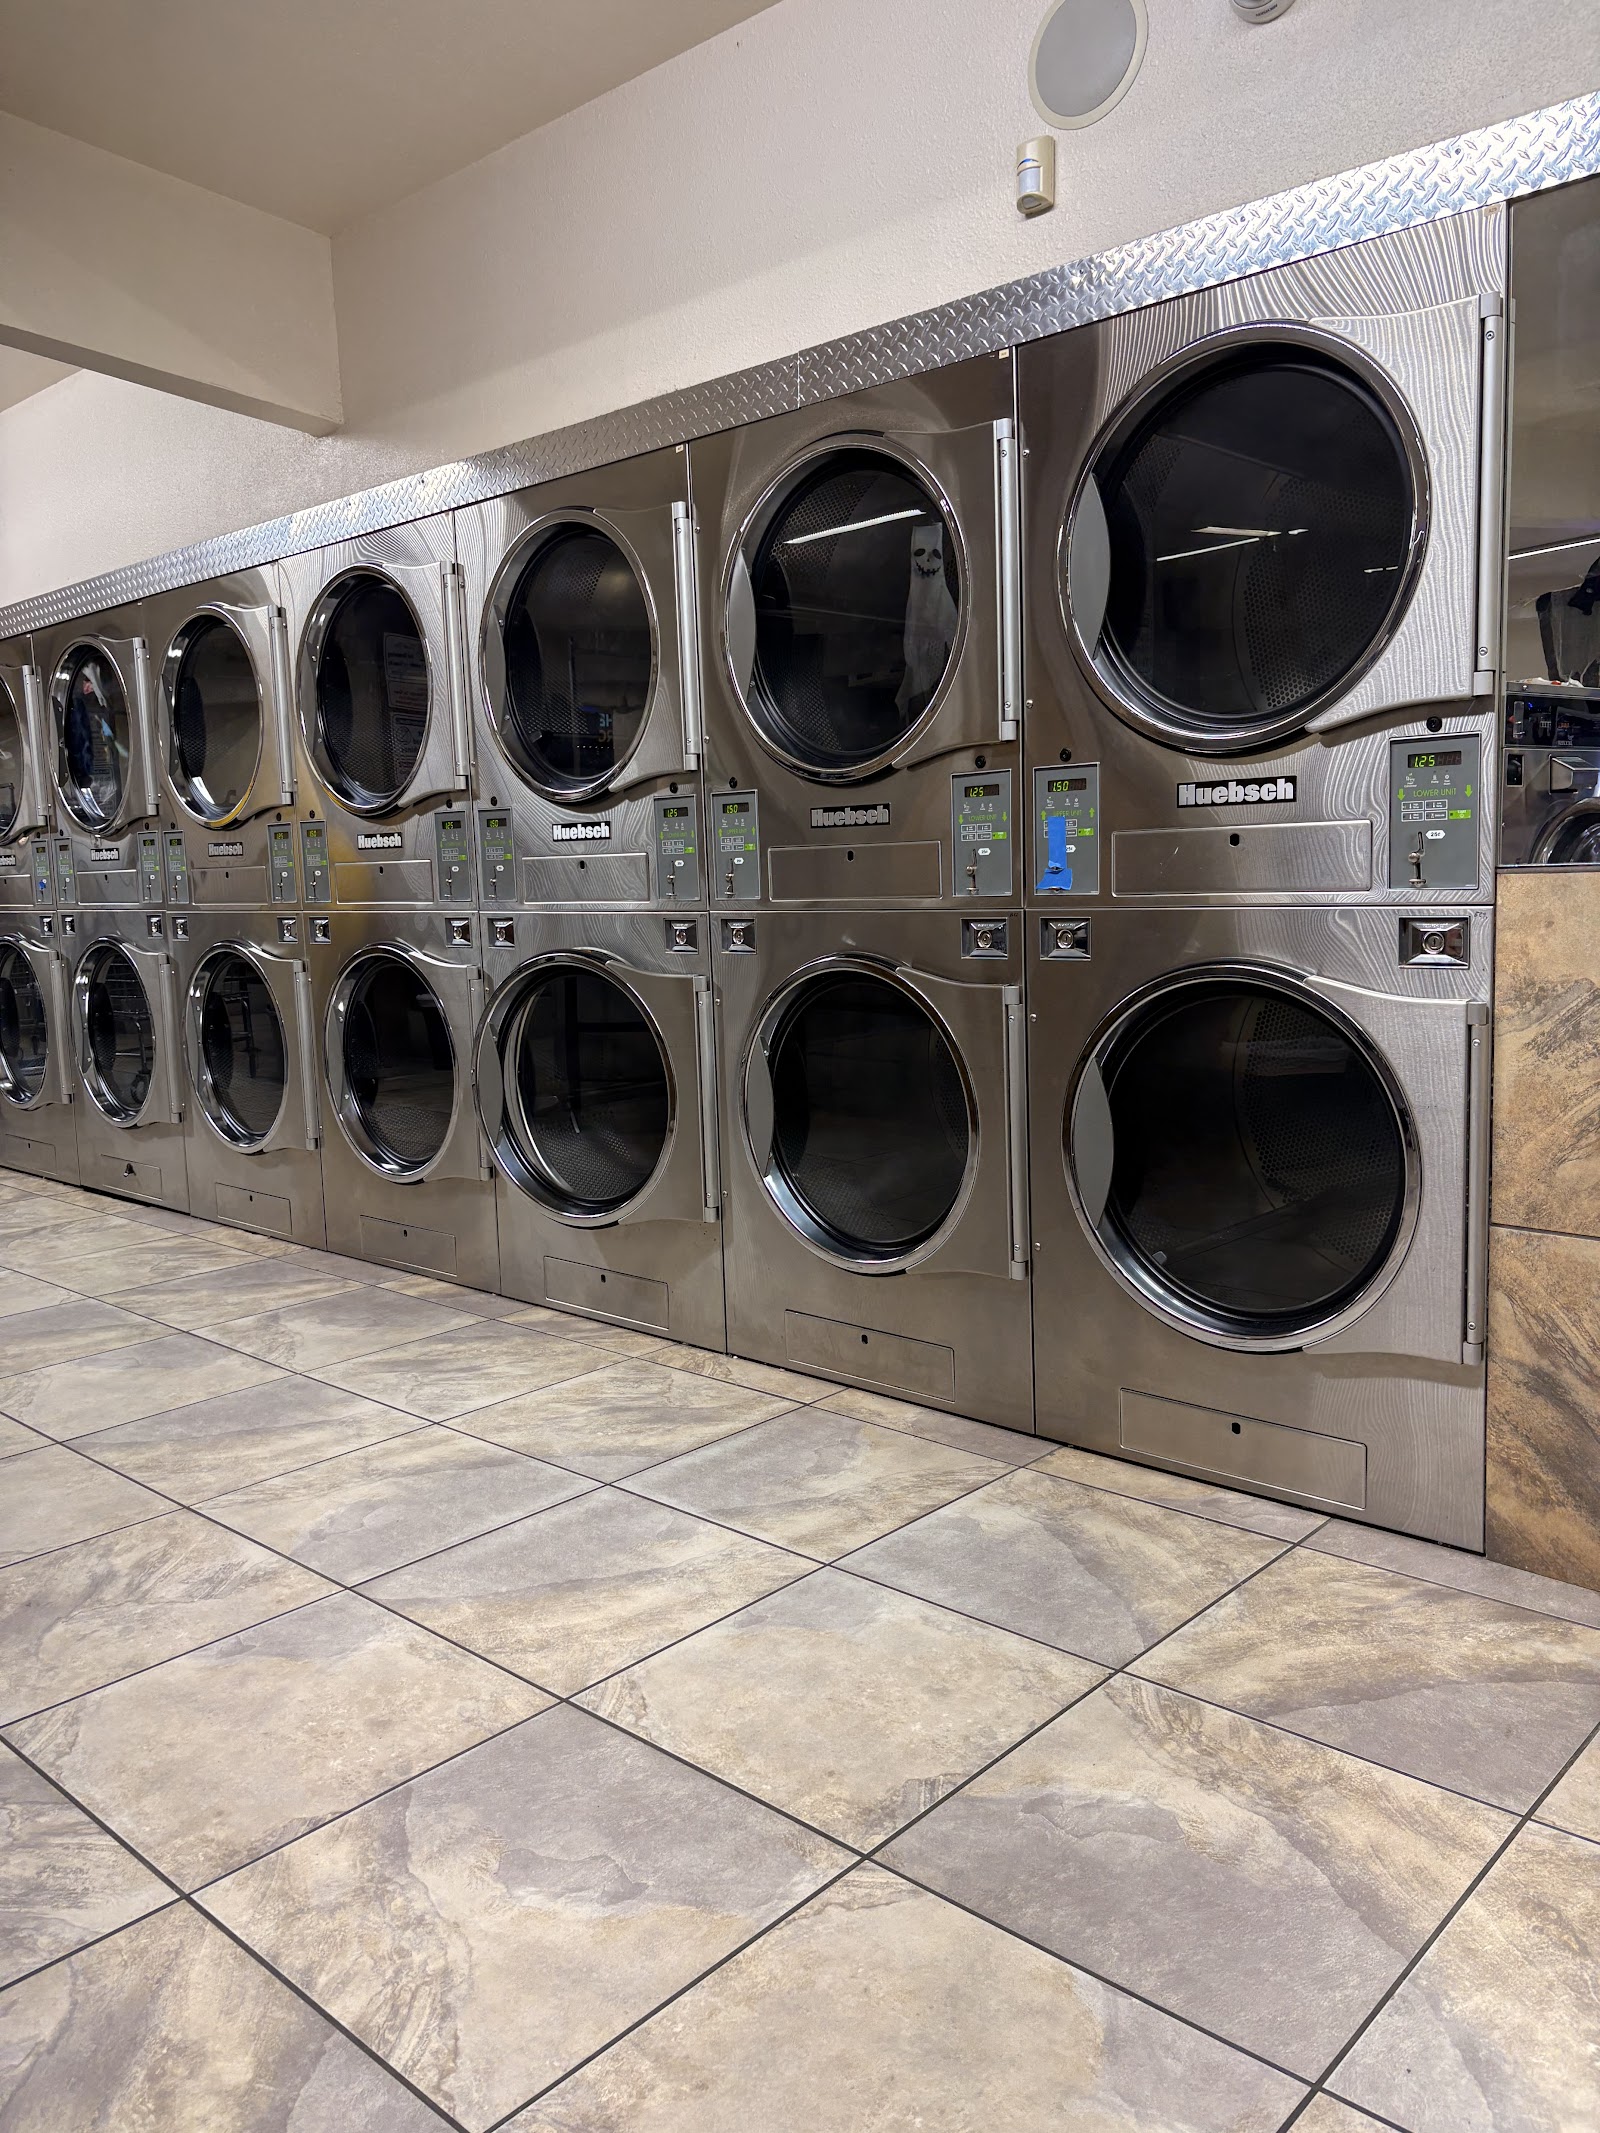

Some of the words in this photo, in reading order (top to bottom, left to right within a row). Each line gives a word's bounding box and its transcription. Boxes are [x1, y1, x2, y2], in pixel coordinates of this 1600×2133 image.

[1178, 778, 1294, 806] Huebsch
[1413, 788, 1439, 798] LOWER
[1441, 787, 1457, 796] UNIT
[811, 804, 889, 827] Huebsch
[552, 822, 610, 840] Huebsch
[208, 842, 243, 856] Huebsch
[357, 832, 402, 849] Huebsch
[91, 849, 118, 861] Huebsch
